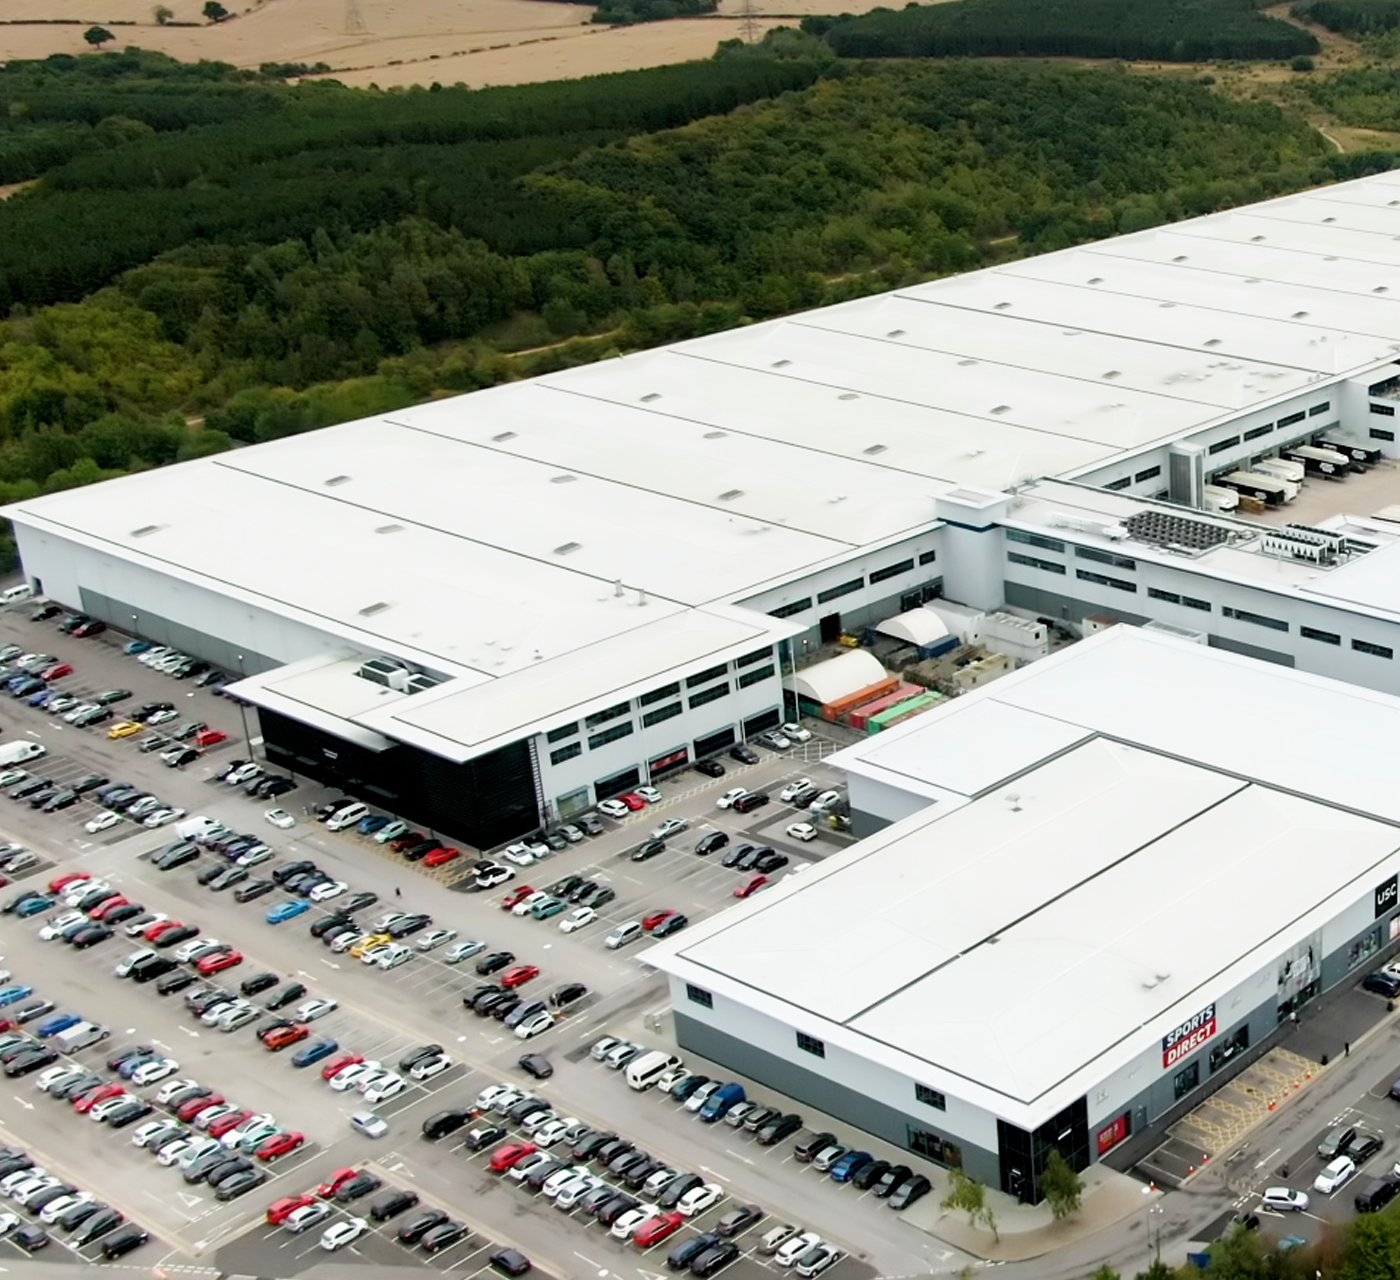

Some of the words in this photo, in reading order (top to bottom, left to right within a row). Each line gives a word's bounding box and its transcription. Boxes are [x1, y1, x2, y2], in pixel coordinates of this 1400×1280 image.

[1378, 883, 1396, 904] USC
[1167, 1005, 1213, 1047] SPORTS
[1168, 1021, 1213, 1064] DIRECT
